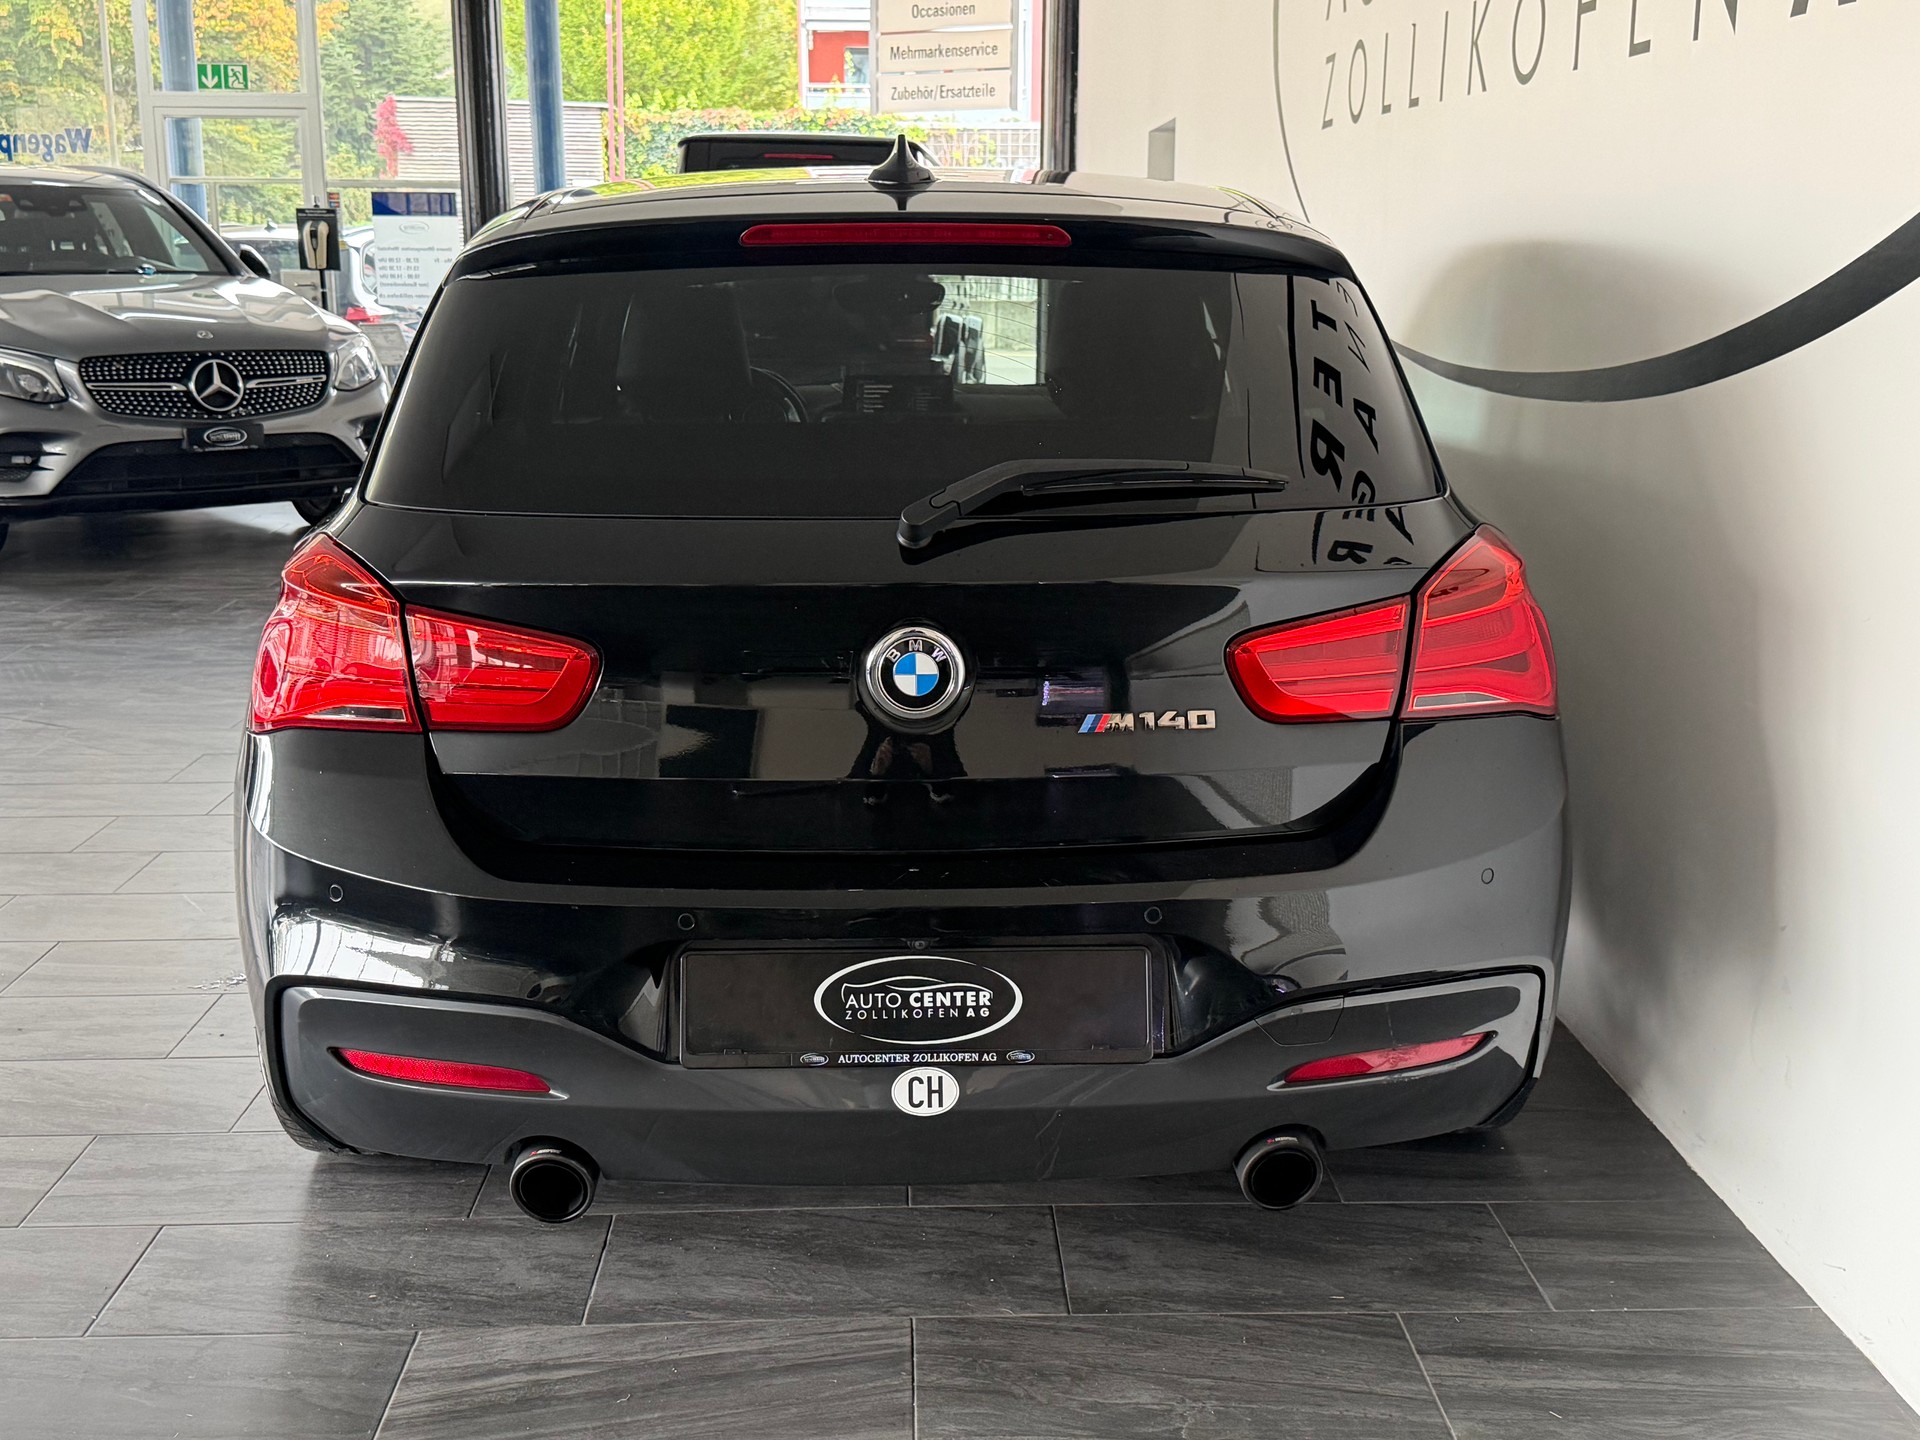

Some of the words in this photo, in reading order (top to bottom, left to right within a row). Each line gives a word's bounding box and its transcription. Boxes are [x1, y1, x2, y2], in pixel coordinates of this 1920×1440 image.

[911, 2, 976, 19] Occasionen
[889, 42, 999, 61] Mehrmarkenservice
[890, 83, 997, 102] Zubehör/Ersatzteile
[886, 639, 947, 663] BMW
[1100, 708, 1217, 732] M140
[845, 993, 902, 1009] AUTO
[909, 991, 992, 1008] CENTER
[845, 1008, 959, 1020] ZOLLIKOFEN
[966, 1007, 990, 1018] AG
[837, 1054, 910, 1064] AUTOCENTER
[912, 1053, 980, 1063] ZOLLIKOFEN
[981, 1052, 997, 1063] AG
[907, 1075, 944, 1109] CH
